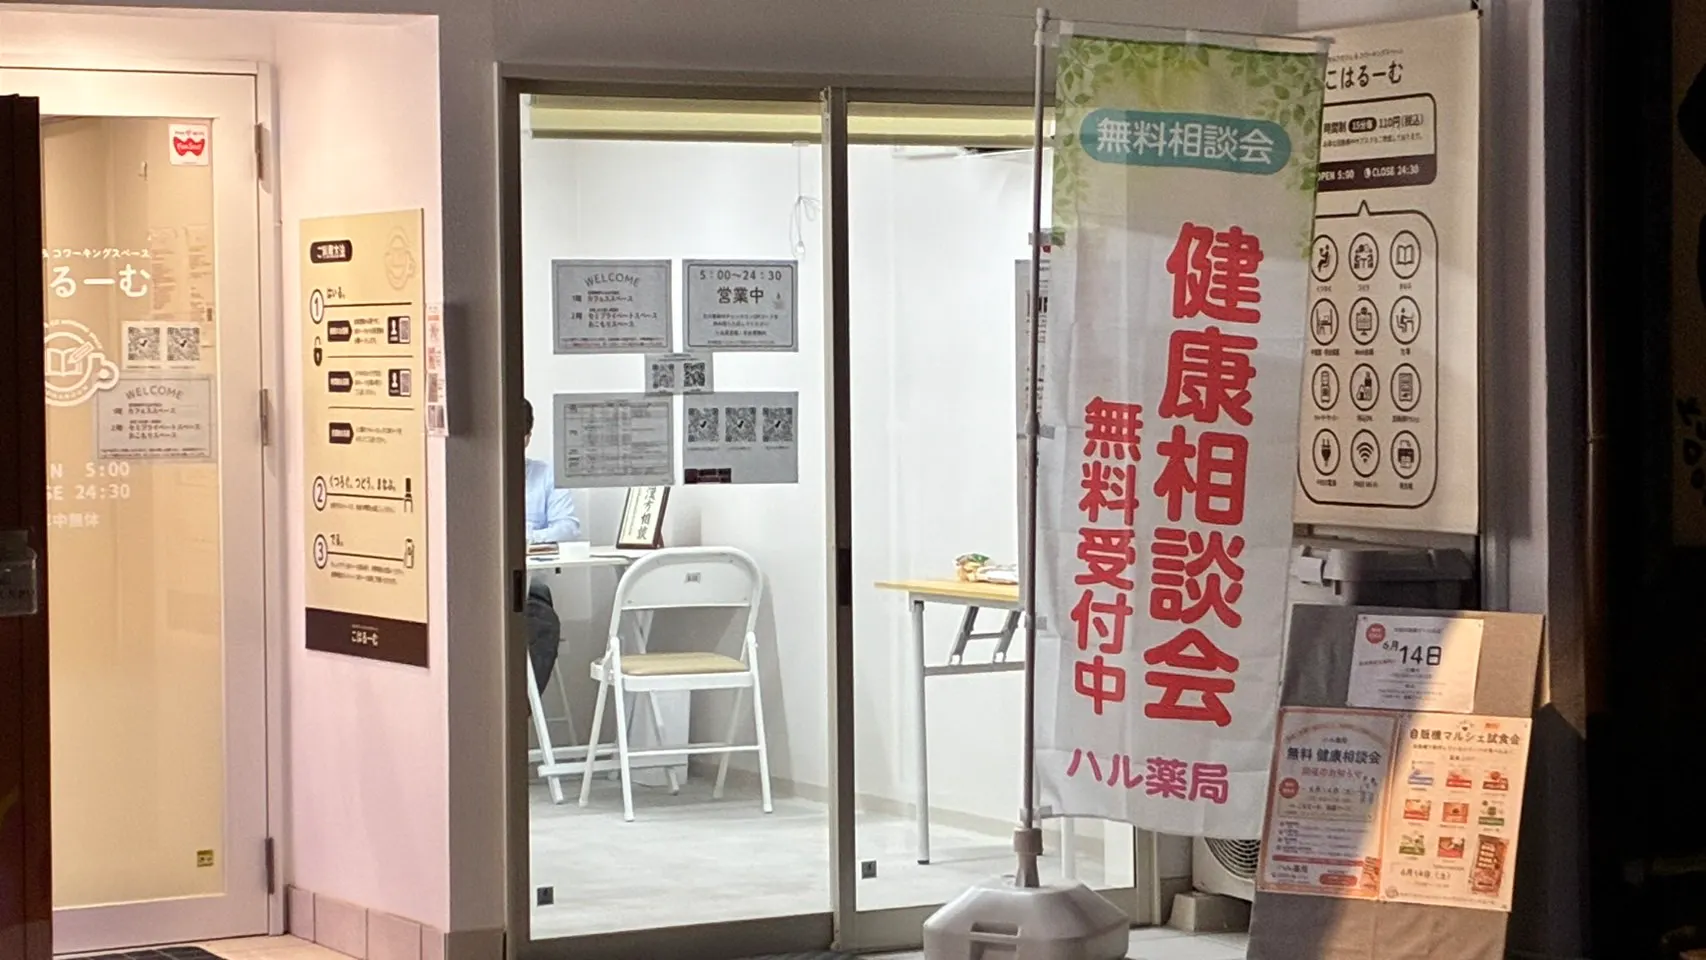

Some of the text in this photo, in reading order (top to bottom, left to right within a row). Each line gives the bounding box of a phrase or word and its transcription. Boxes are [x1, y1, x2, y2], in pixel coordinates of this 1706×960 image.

[1326, 60, 1403, 89] こはるーむ
[1096, 117, 1274, 165] 無料相談会
[1372, 167, 1395, 177] CLOSE
[1397, 164, 1419, 175] 24:30
[53, 248, 151, 259] コワーキングスペース
[584, 272, 641, 287] WELCOME
[717, 286, 764, 304] 営業中
[125, 385, 184, 400] WELCOME
[86, 462, 130, 477] 5:00
[1144, 220, 1266, 727] 健康相談会
[74, 484, 130, 500] 24:30
[1070, 396, 1144, 716] 無料受付中
[1382, 640, 1442, 666] 6月14日
[1287, 747, 1382, 764] 無料 健康相談会
[1066, 747, 1231, 803] ハル薬局
